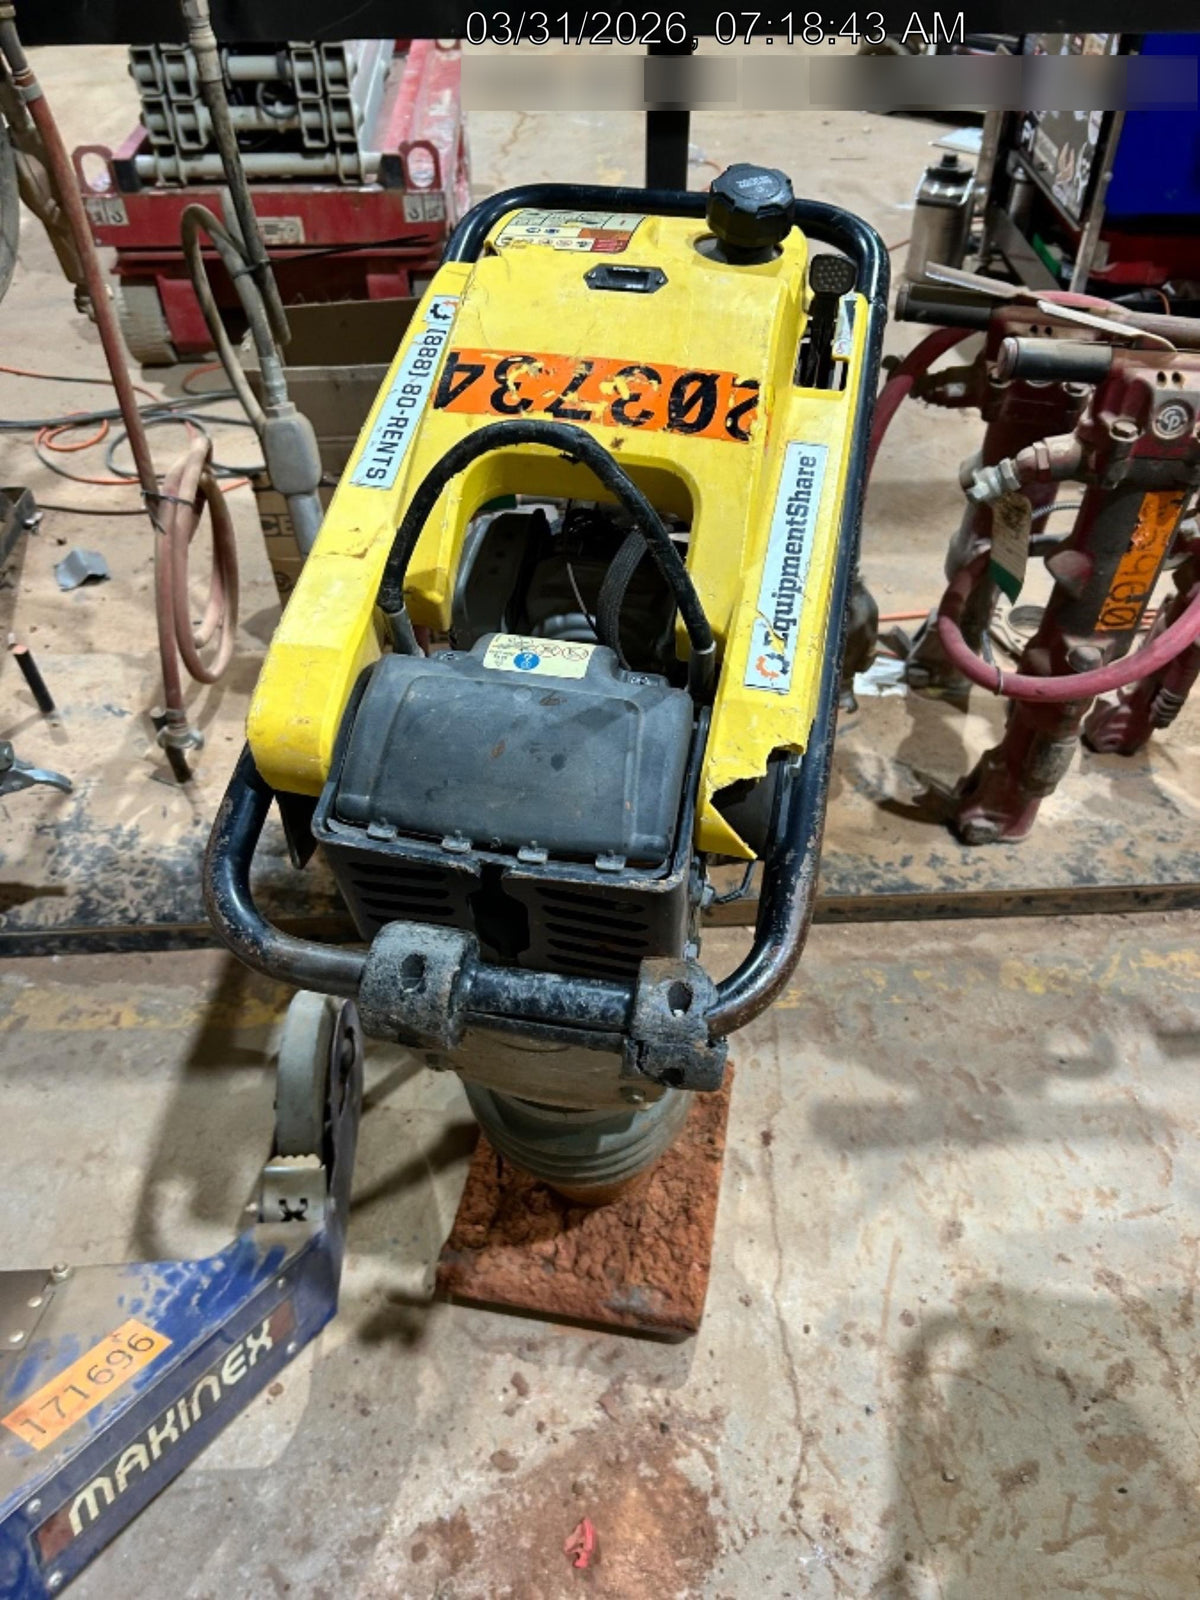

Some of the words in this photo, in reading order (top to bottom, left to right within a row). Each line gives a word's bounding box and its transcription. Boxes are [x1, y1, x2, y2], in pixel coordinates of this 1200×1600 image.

[366, 383, 422, 480] 80-RENTS
[21, 1332, 155, 1436] 171696
[68, 1318, 274, 1537] MAKINEX
